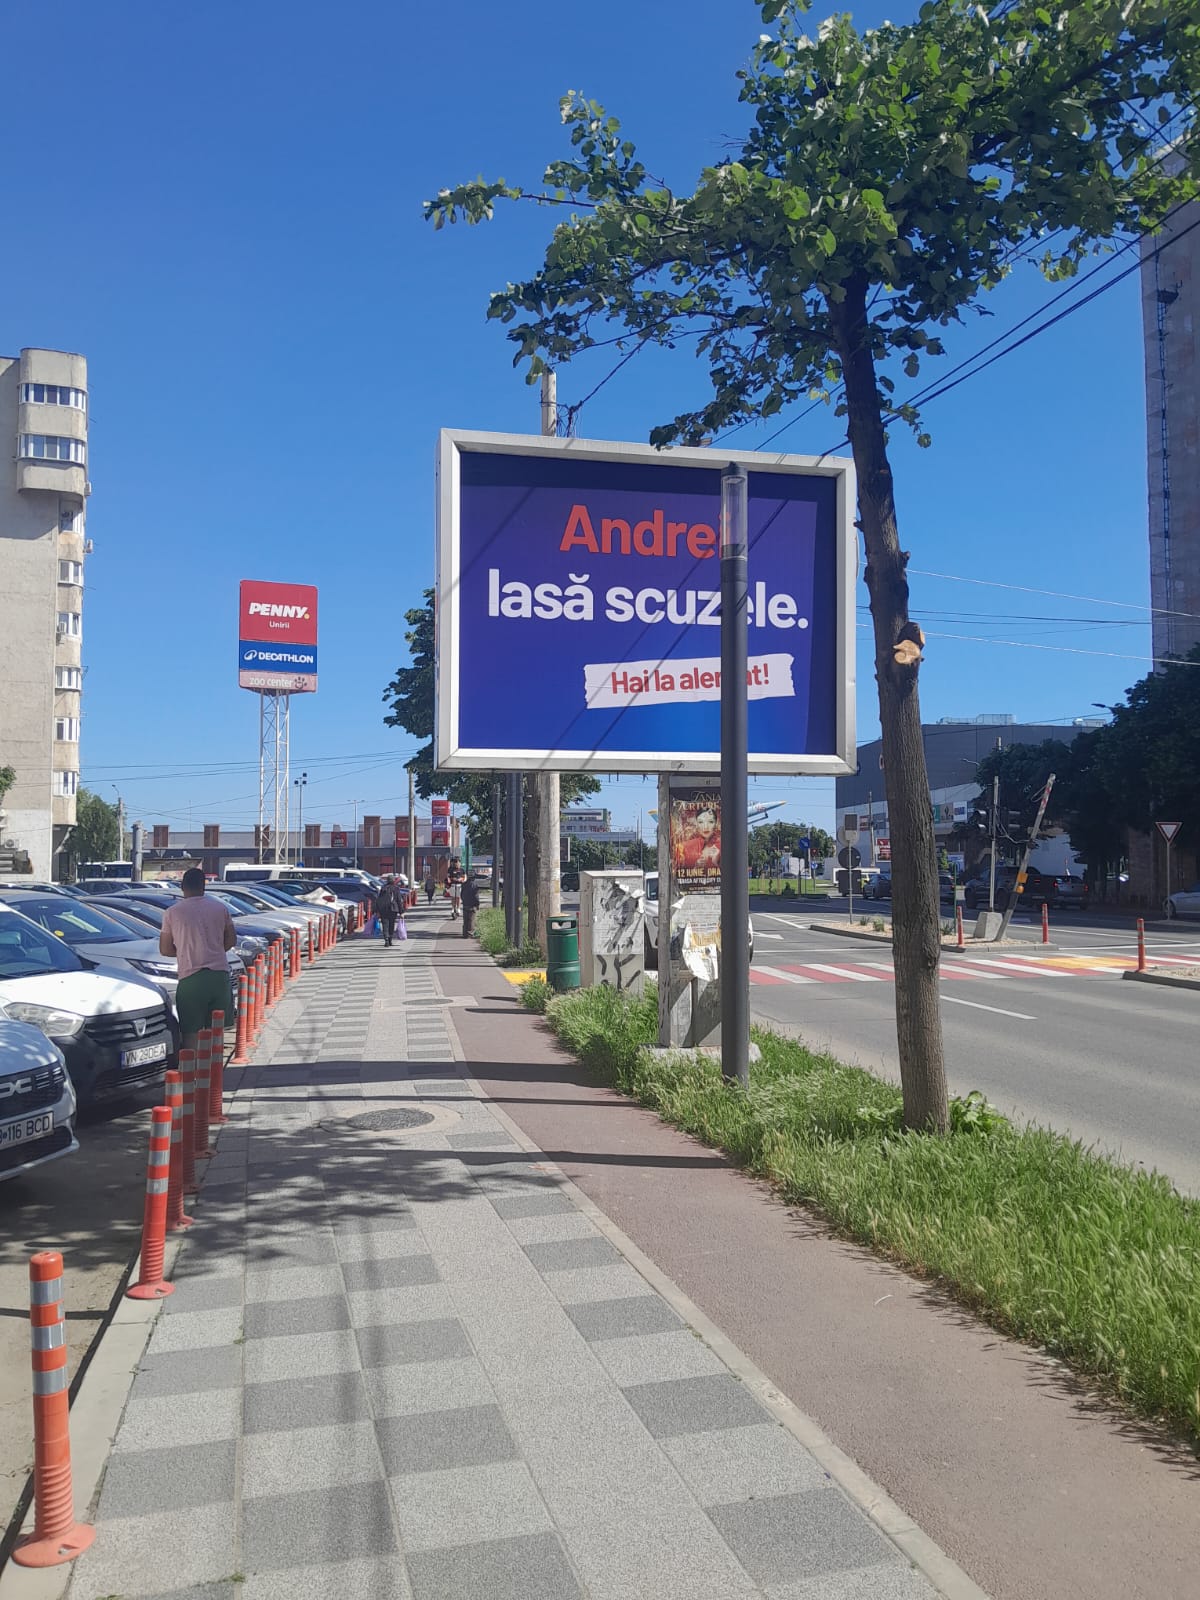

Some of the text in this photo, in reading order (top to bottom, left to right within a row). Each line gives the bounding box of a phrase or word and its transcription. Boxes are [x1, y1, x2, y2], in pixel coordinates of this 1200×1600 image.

[488, 568, 809, 629] lasă scuzle.
[269, 620, 290, 629] Unirii
[258, 651, 314, 663] DECATHLON
[611, 663, 769, 694] Hai la alert!
[678, 868, 685, 878] 12
[8, 1123, 22, 1141] 116
[26, 1115, 50, 1136] BCD
